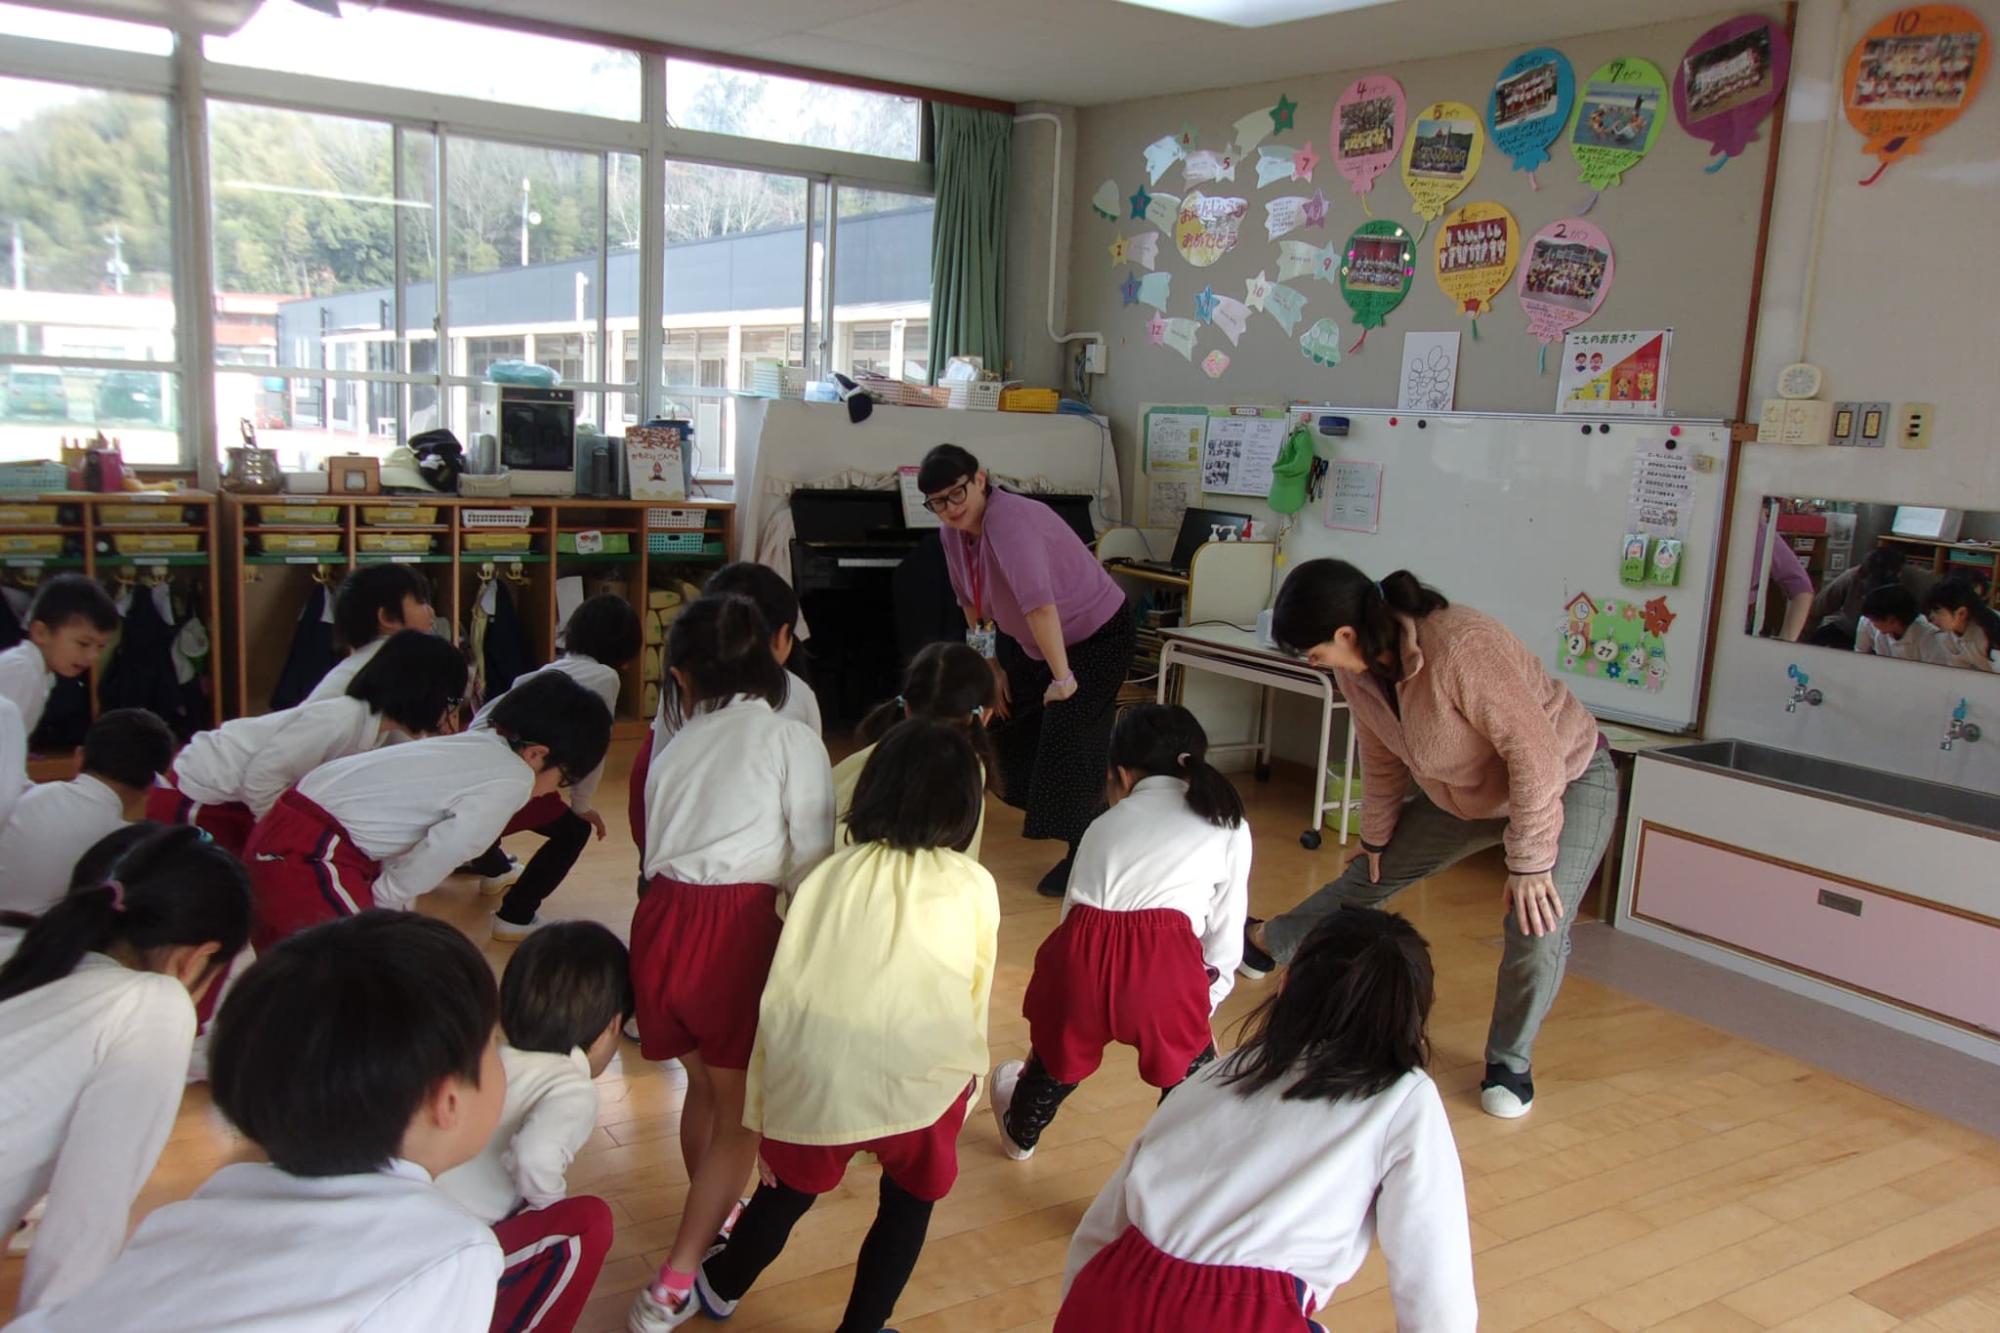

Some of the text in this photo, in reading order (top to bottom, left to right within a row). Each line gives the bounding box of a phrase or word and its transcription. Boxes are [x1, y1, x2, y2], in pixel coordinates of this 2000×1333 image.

[1302, 157, 1310, 170] 7
[1573, 333, 1637, 345] こえのおおきさ
[1598, 646, 1612, 657] 27
